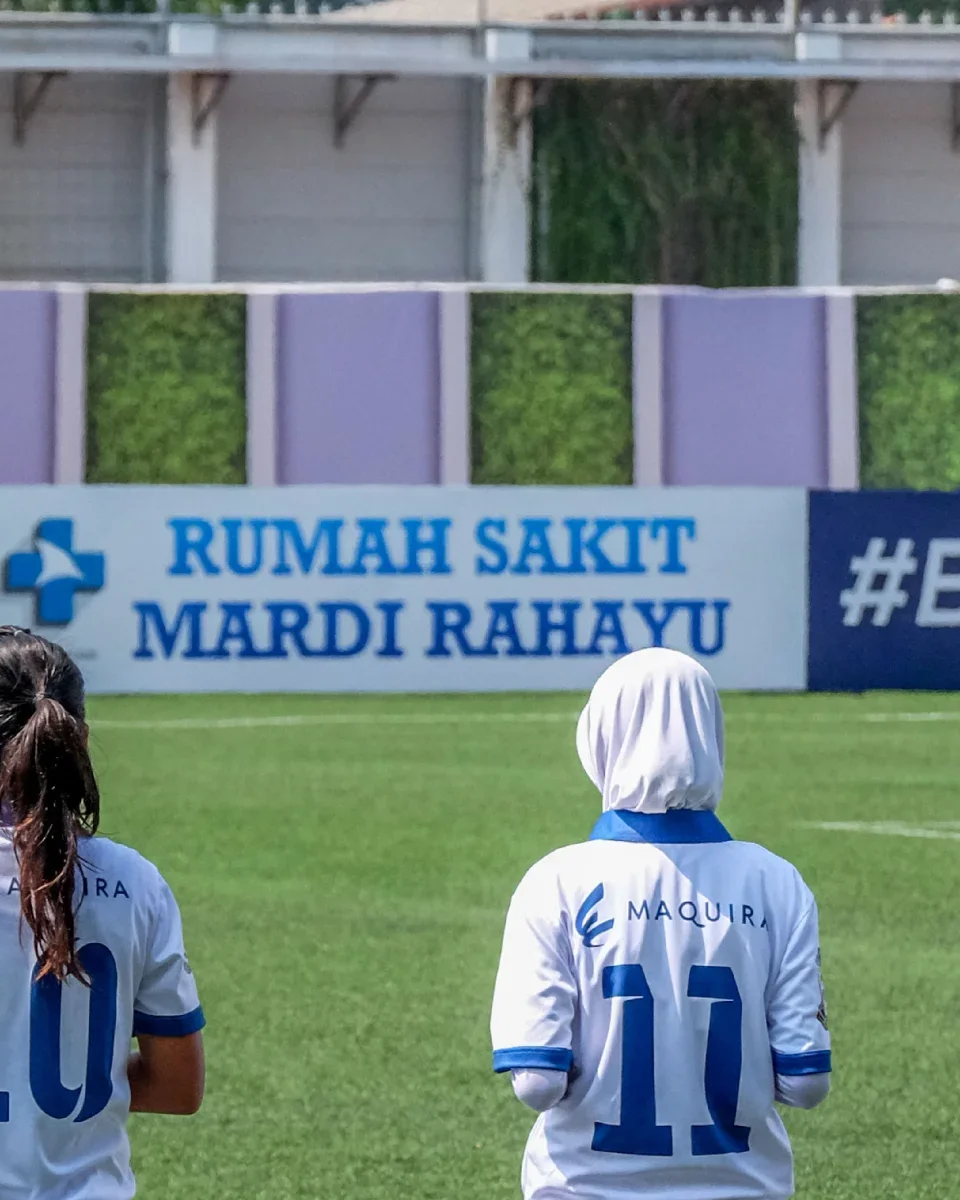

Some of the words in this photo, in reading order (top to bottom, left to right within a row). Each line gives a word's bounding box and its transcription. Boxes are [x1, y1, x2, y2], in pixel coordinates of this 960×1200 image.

[167, 517, 452, 576] RUMAH
[474, 516, 697, 576] SAKIT
[132, 601, 406, 660] MARDI
[425, 599, 731, 659] RAHAYU
[591, 963, 751, 1157] 11
